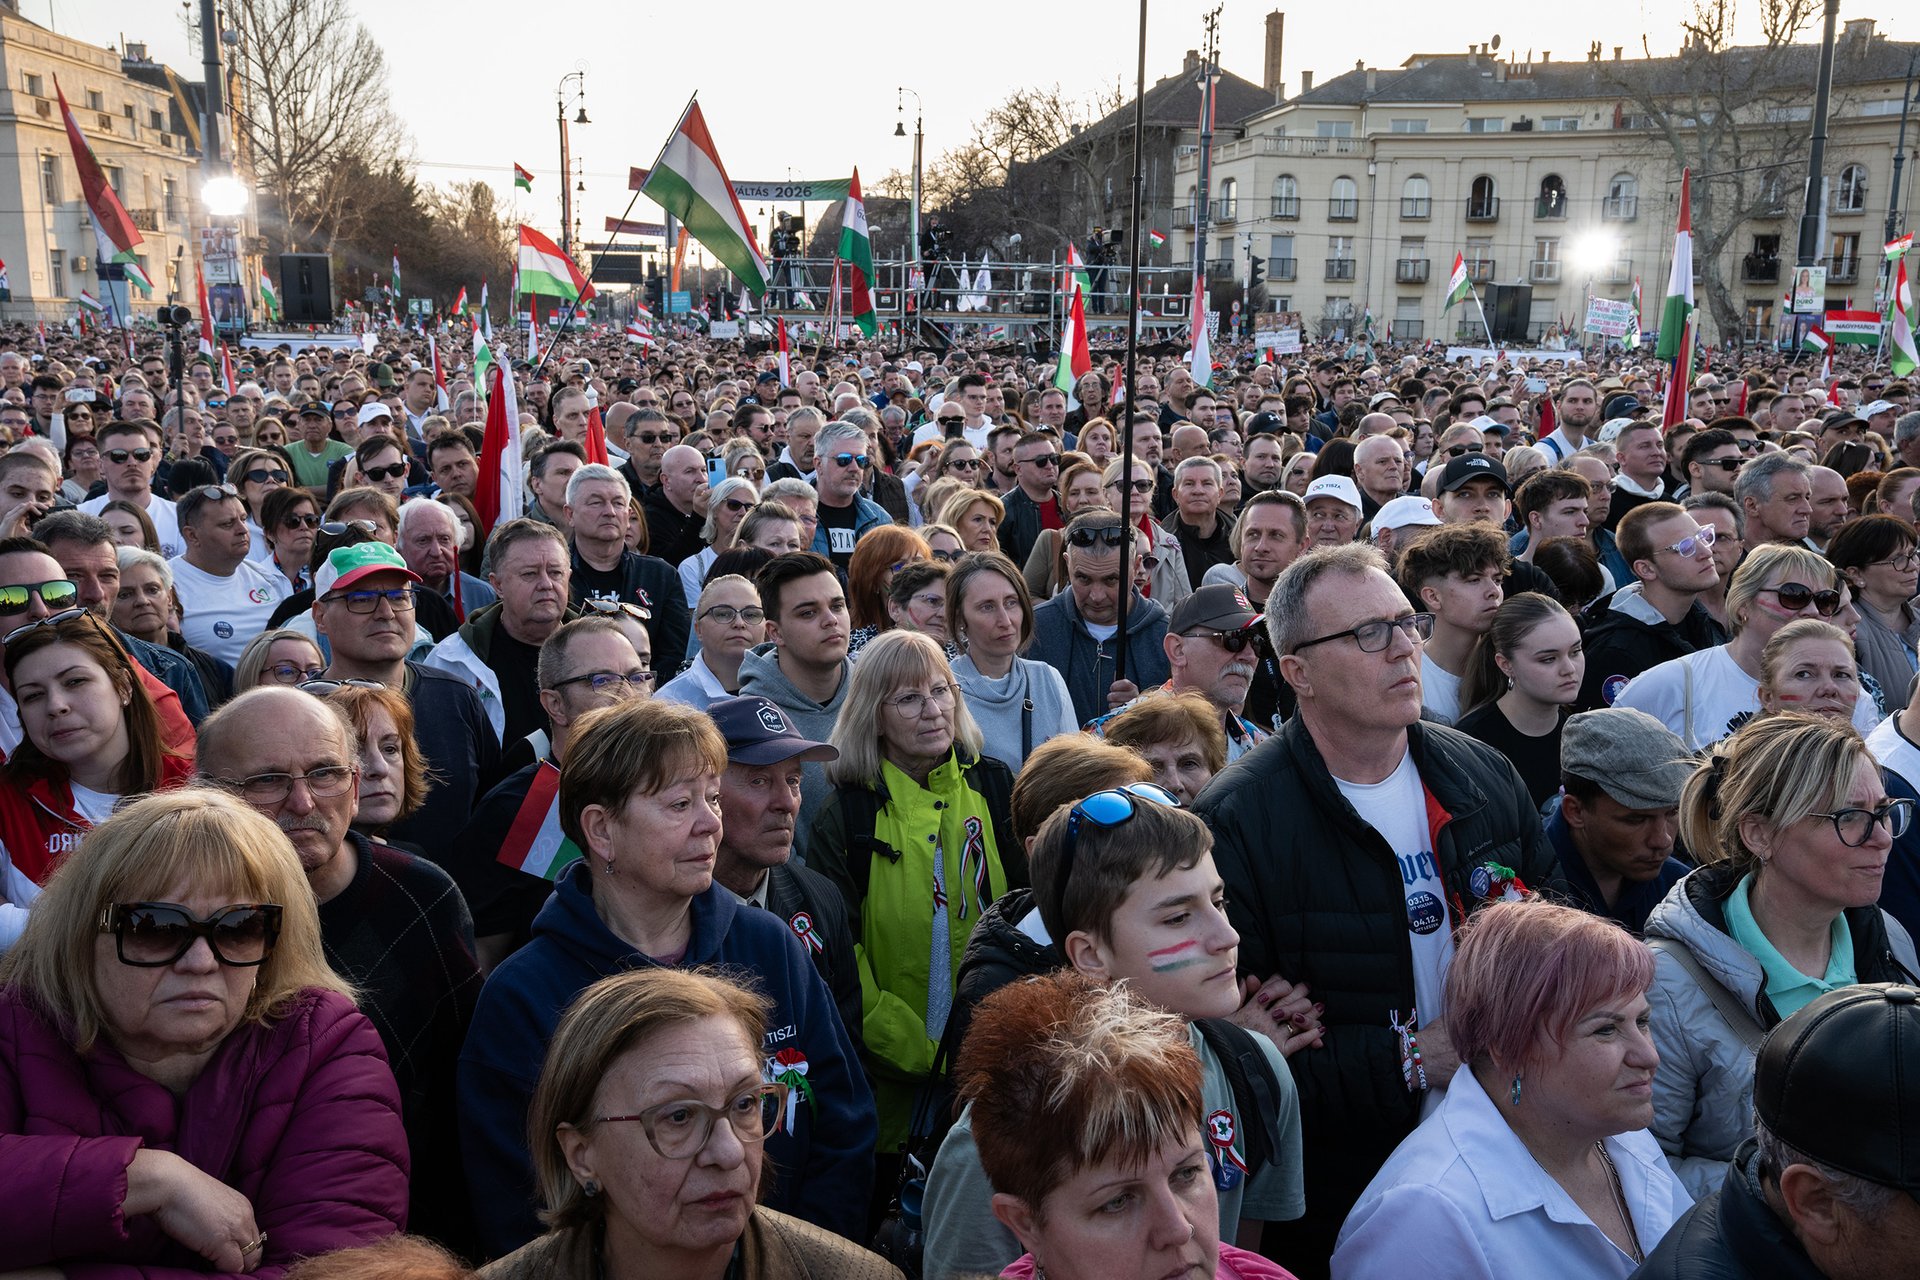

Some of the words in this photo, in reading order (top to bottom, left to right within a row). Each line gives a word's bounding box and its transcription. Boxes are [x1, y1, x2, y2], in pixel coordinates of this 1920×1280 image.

[775, 186, 812, 198] 2026
[1835, 323, 1876, 331] NAGYMAROS
[1407, 893, 1432, 907] 03.15.
[1413, 915, 1439, 928] 04.12.
